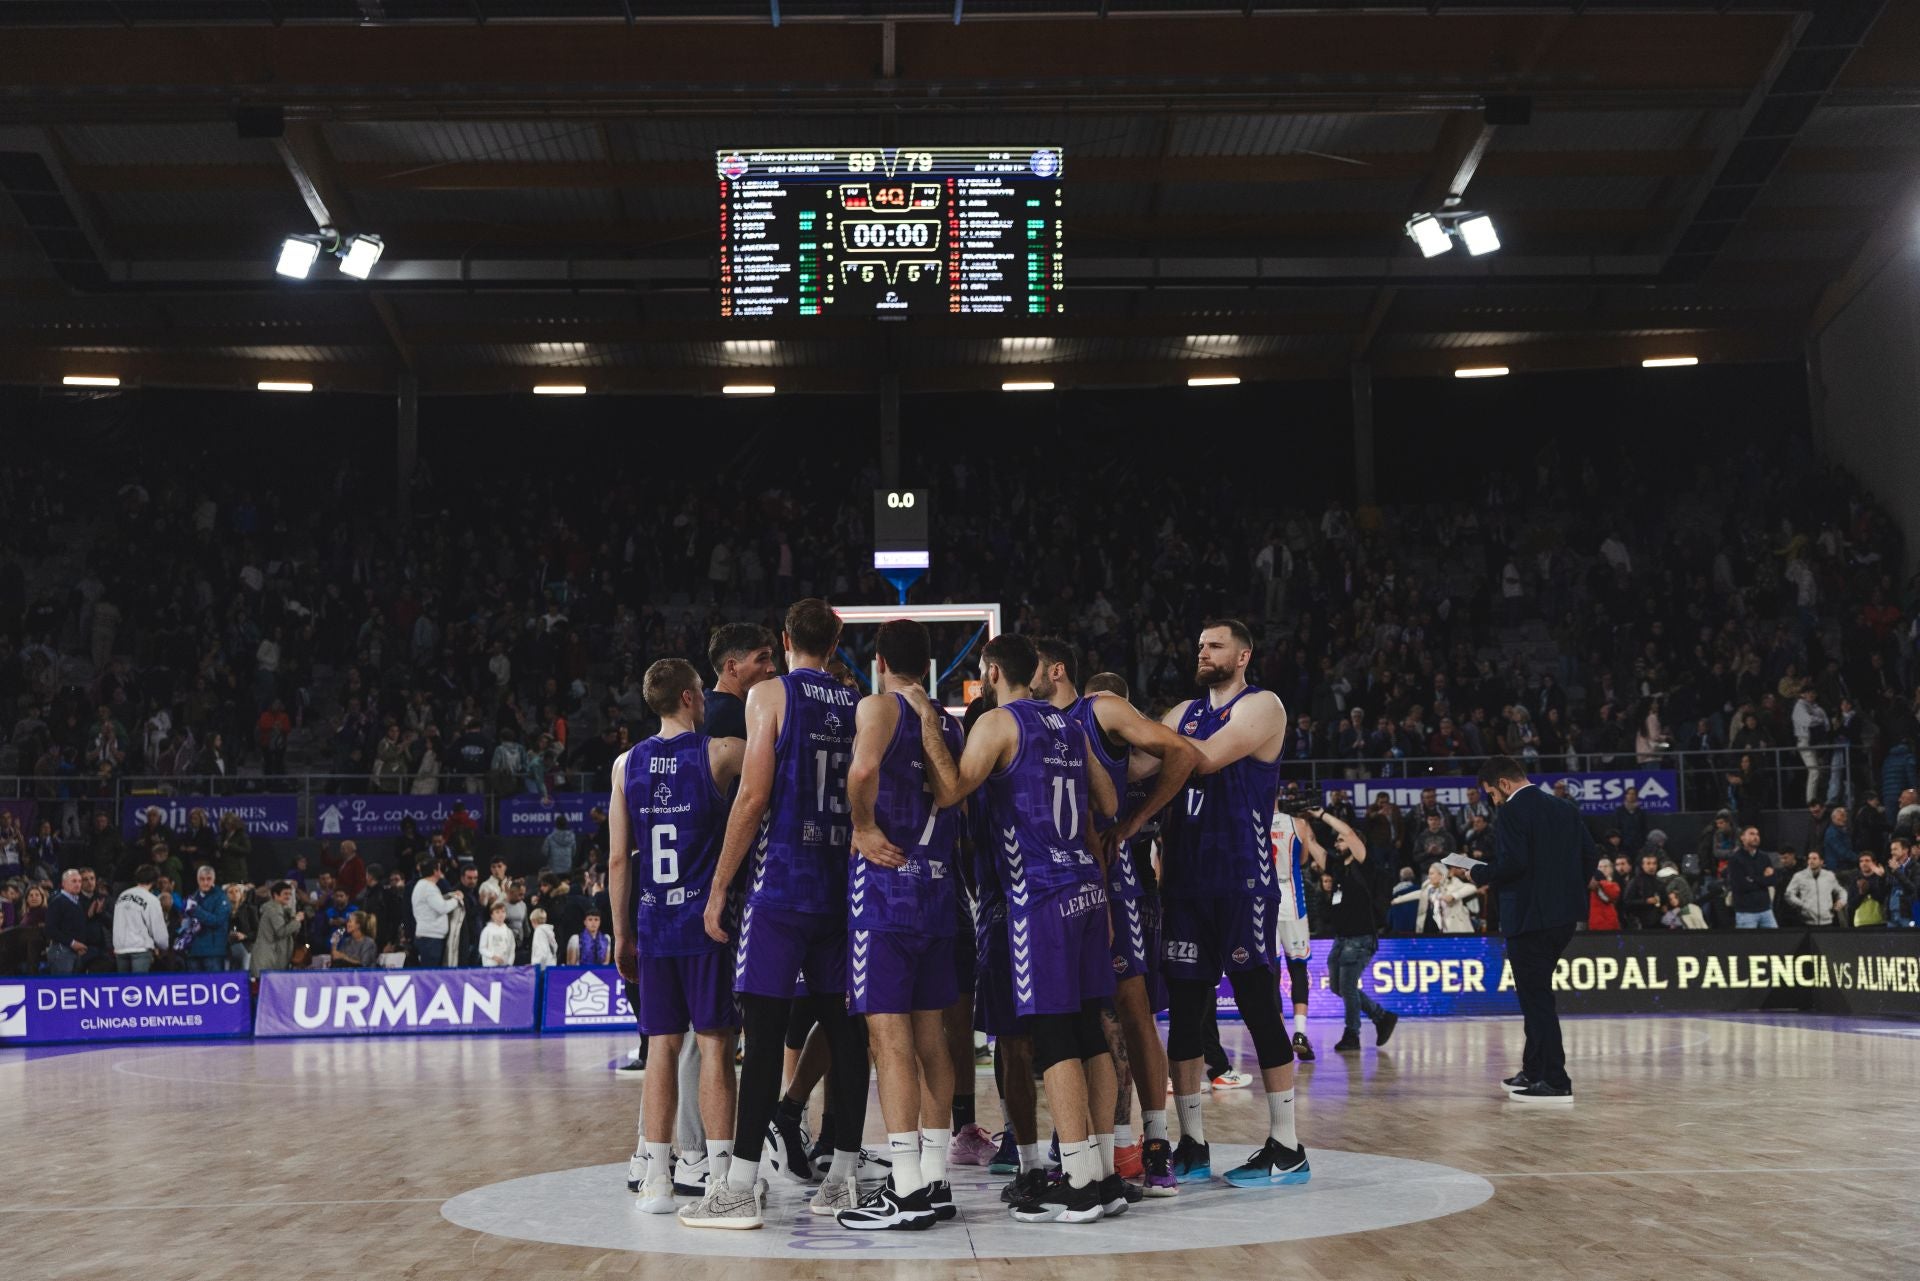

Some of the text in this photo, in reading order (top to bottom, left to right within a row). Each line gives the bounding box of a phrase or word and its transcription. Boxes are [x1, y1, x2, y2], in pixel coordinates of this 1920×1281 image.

[848, 153, 875, 172] 59
[904, 153, 933, 172] 79
[875, 188, 904, 206] 4Q
[853, 223, 929, 247] 00:00
[887, 492, 915, 508] 0.0
[815, 749, 851, 814] 13
[352, 799, 379, 821] La
[1051, 776, 1079, 840] 11
[1187, 788, 1205, 816] 17
[651, 823, 679, 884] 6
[1372, 959, 1486, 993] SUPER
[1496, 956, 1669, 992] AROPAL
[1676, 954, 1832, 989] PALENCIA
[37, 982, 241, 1011] DENTOMEDIC
[293, 976, 502, 1028] URMAN
[80, 1015, 203, 1029] CLÍNICAS DENTALES
